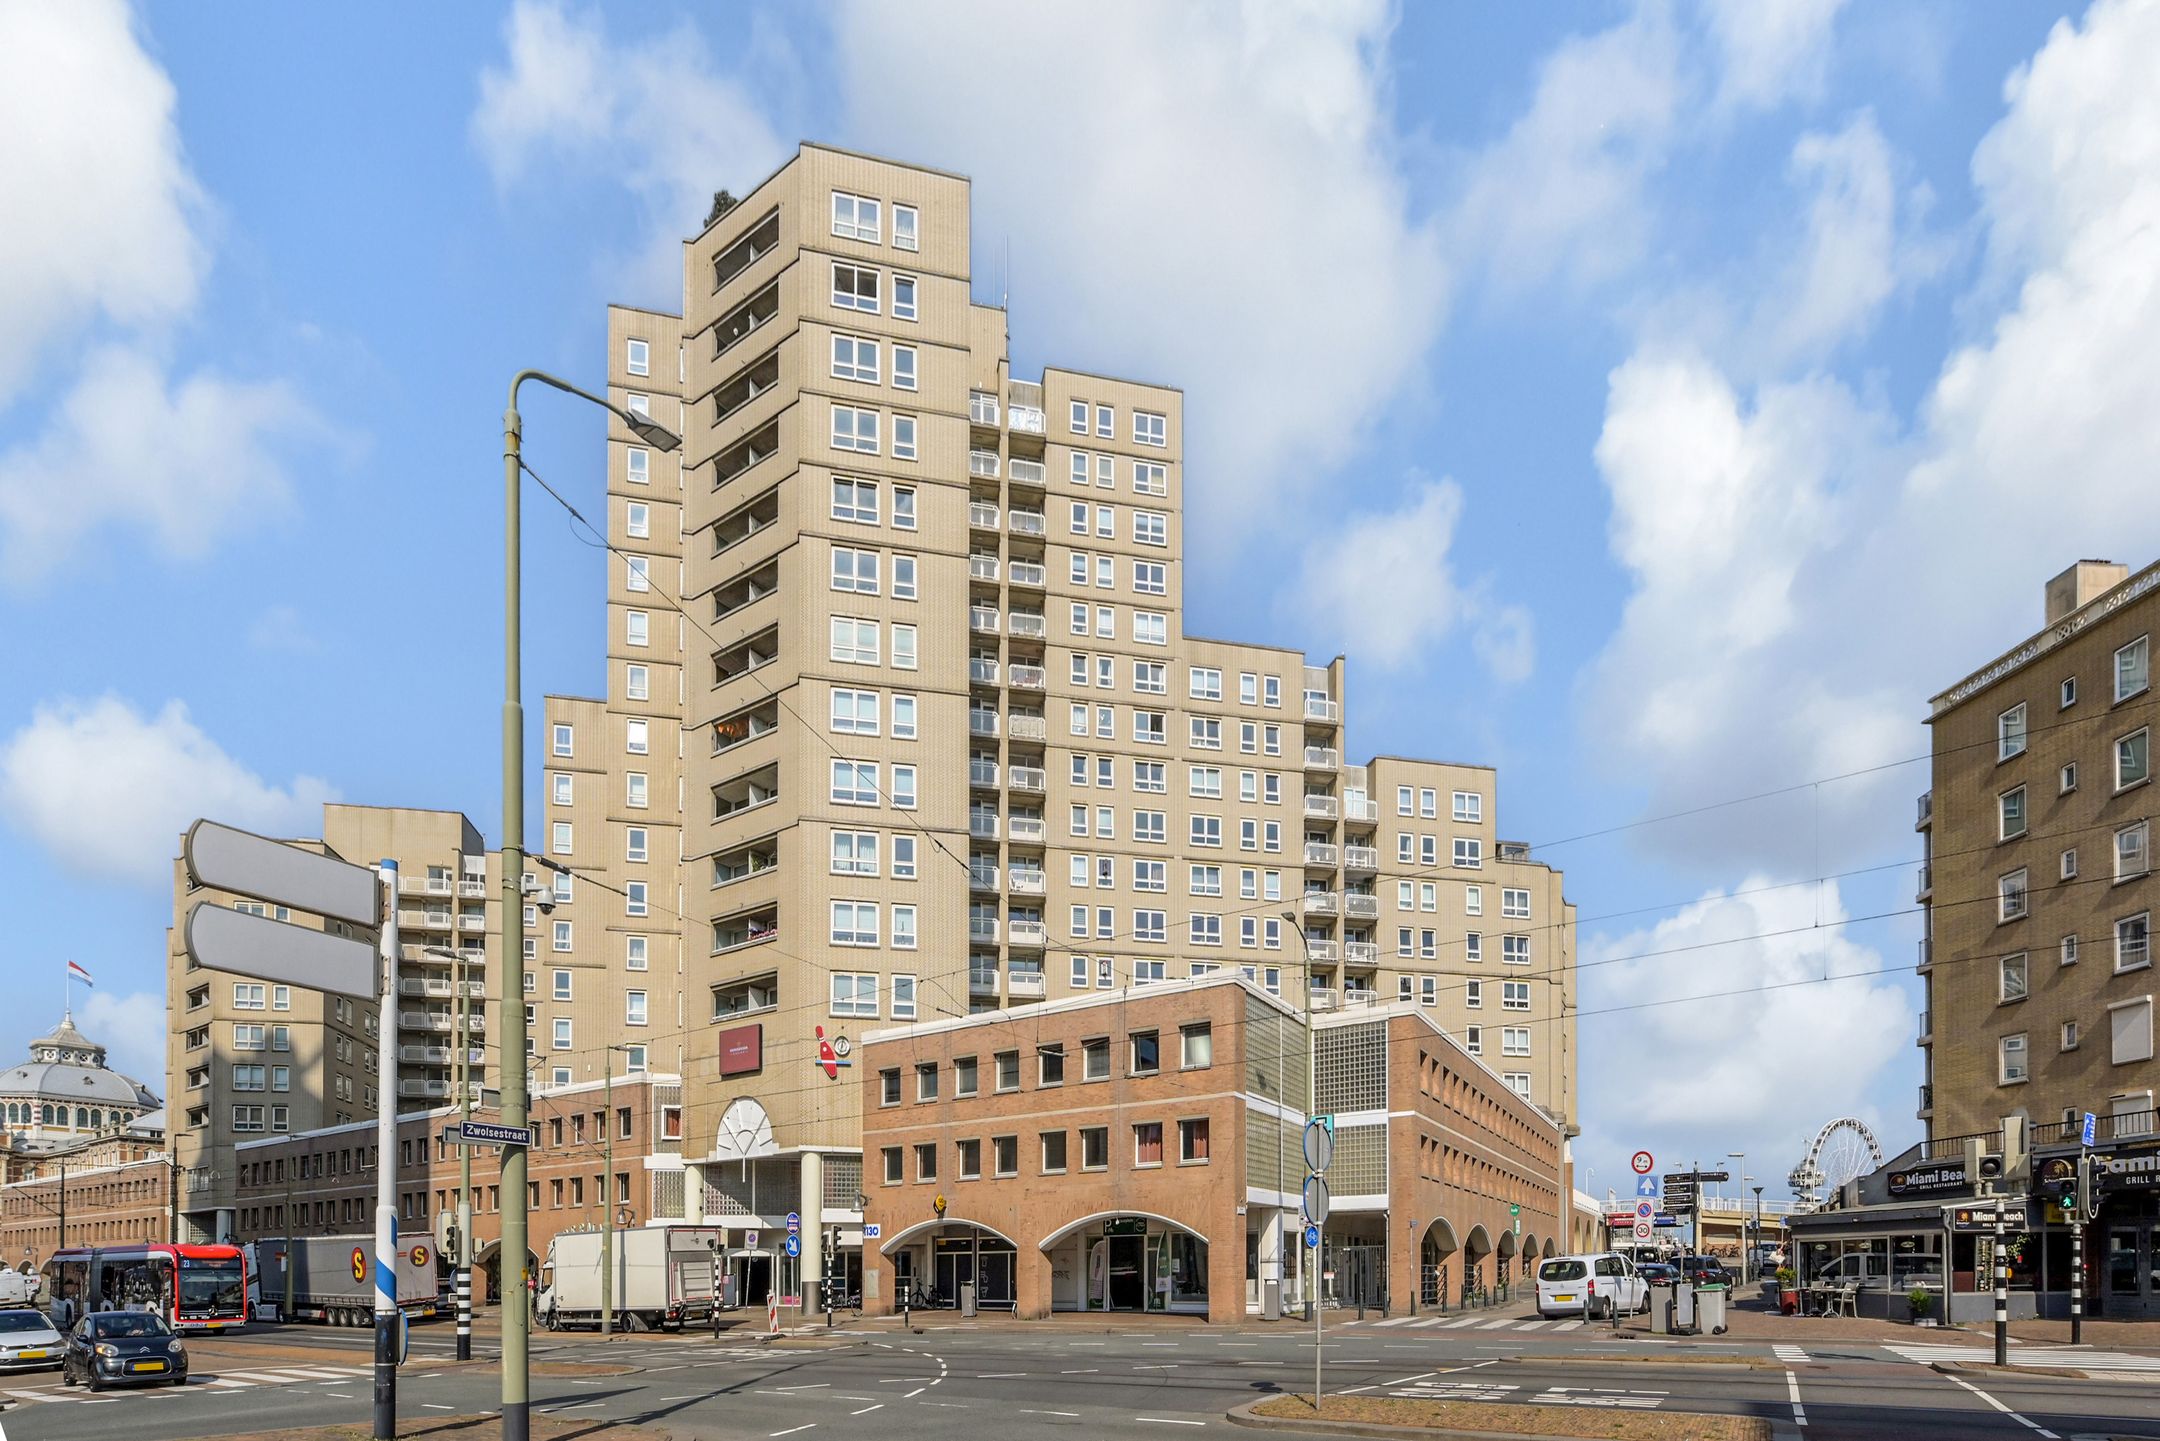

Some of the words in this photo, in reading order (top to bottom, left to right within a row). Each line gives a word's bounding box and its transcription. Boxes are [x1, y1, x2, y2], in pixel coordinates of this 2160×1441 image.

[466, 1124, 527, 1141] Zwolsestraat
[1906, 1170, 1939, 1186] Miami
[2126, 1175, 2150, 1185] GRILL
[1933, 1181, 1963, 1189] RESTAURANT
[1972, 1211, 1996, 1221] Miam
[2003, 1211, 2024, 1221] each
[414, 1247, 425, 1265] S
[183, 1259, 191, 1268] 23
[354, 1251, 364, 1279] S
